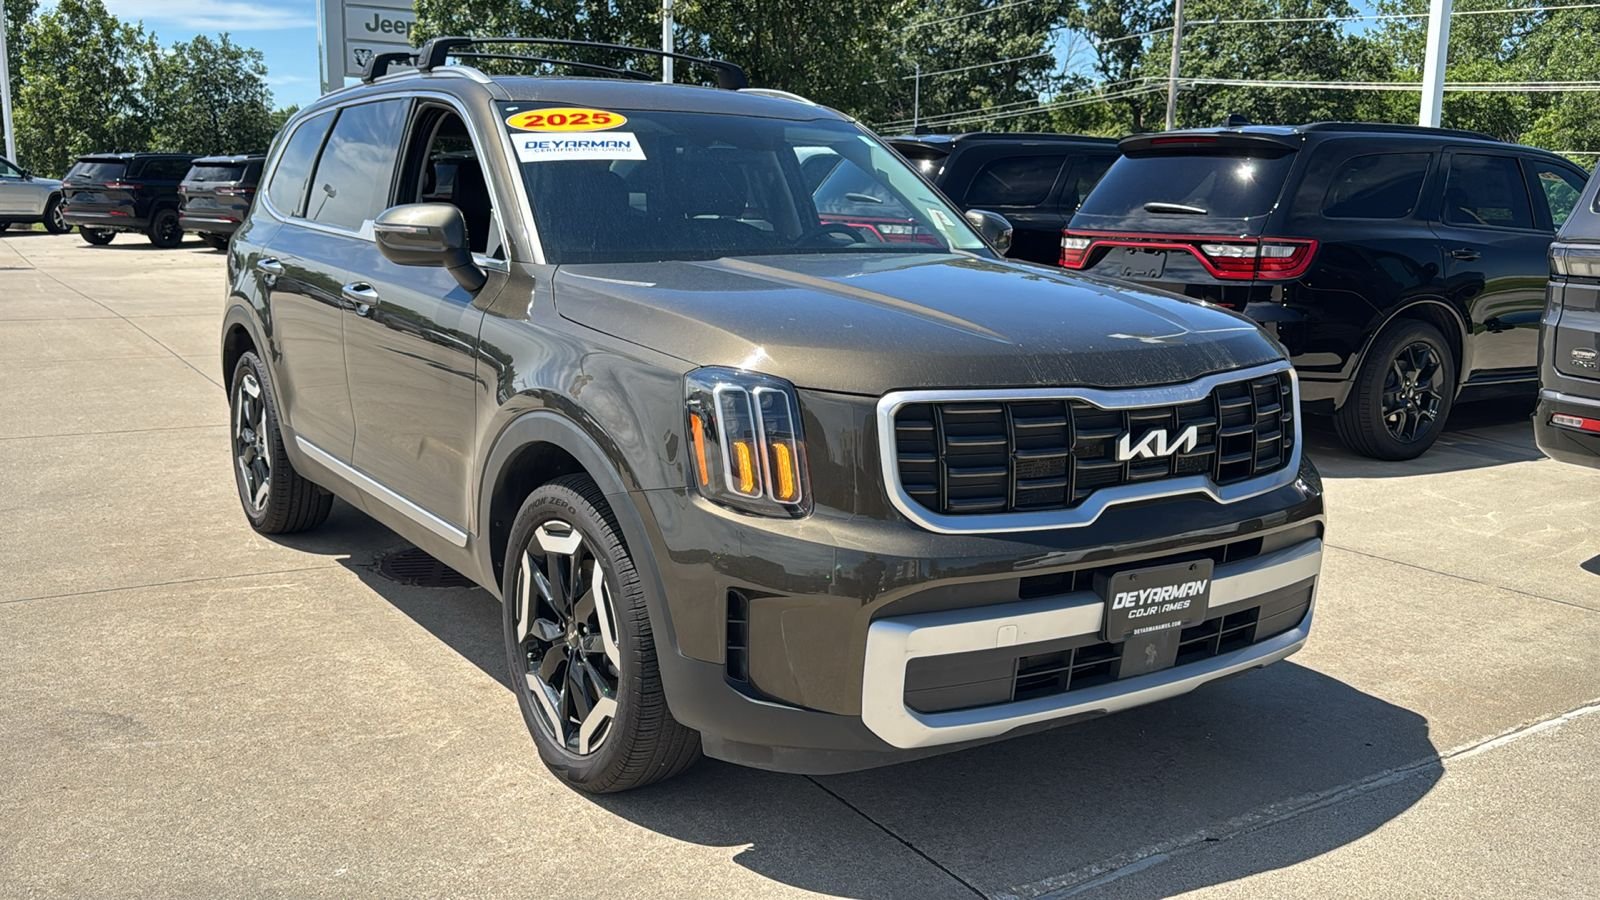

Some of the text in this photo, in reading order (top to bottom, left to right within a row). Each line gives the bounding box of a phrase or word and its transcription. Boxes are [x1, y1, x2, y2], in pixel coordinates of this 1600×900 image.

[523, 112, 612, 128] 2025
[524, 140, 631, 149] DEYARMAN
[1118, 424, 1198, 460] KIA
[548, 496, 577, 515] ZERO
[1112, 579, 1208, 610] DEYARMAN
[1161, 599, 1192, 613] AMES
